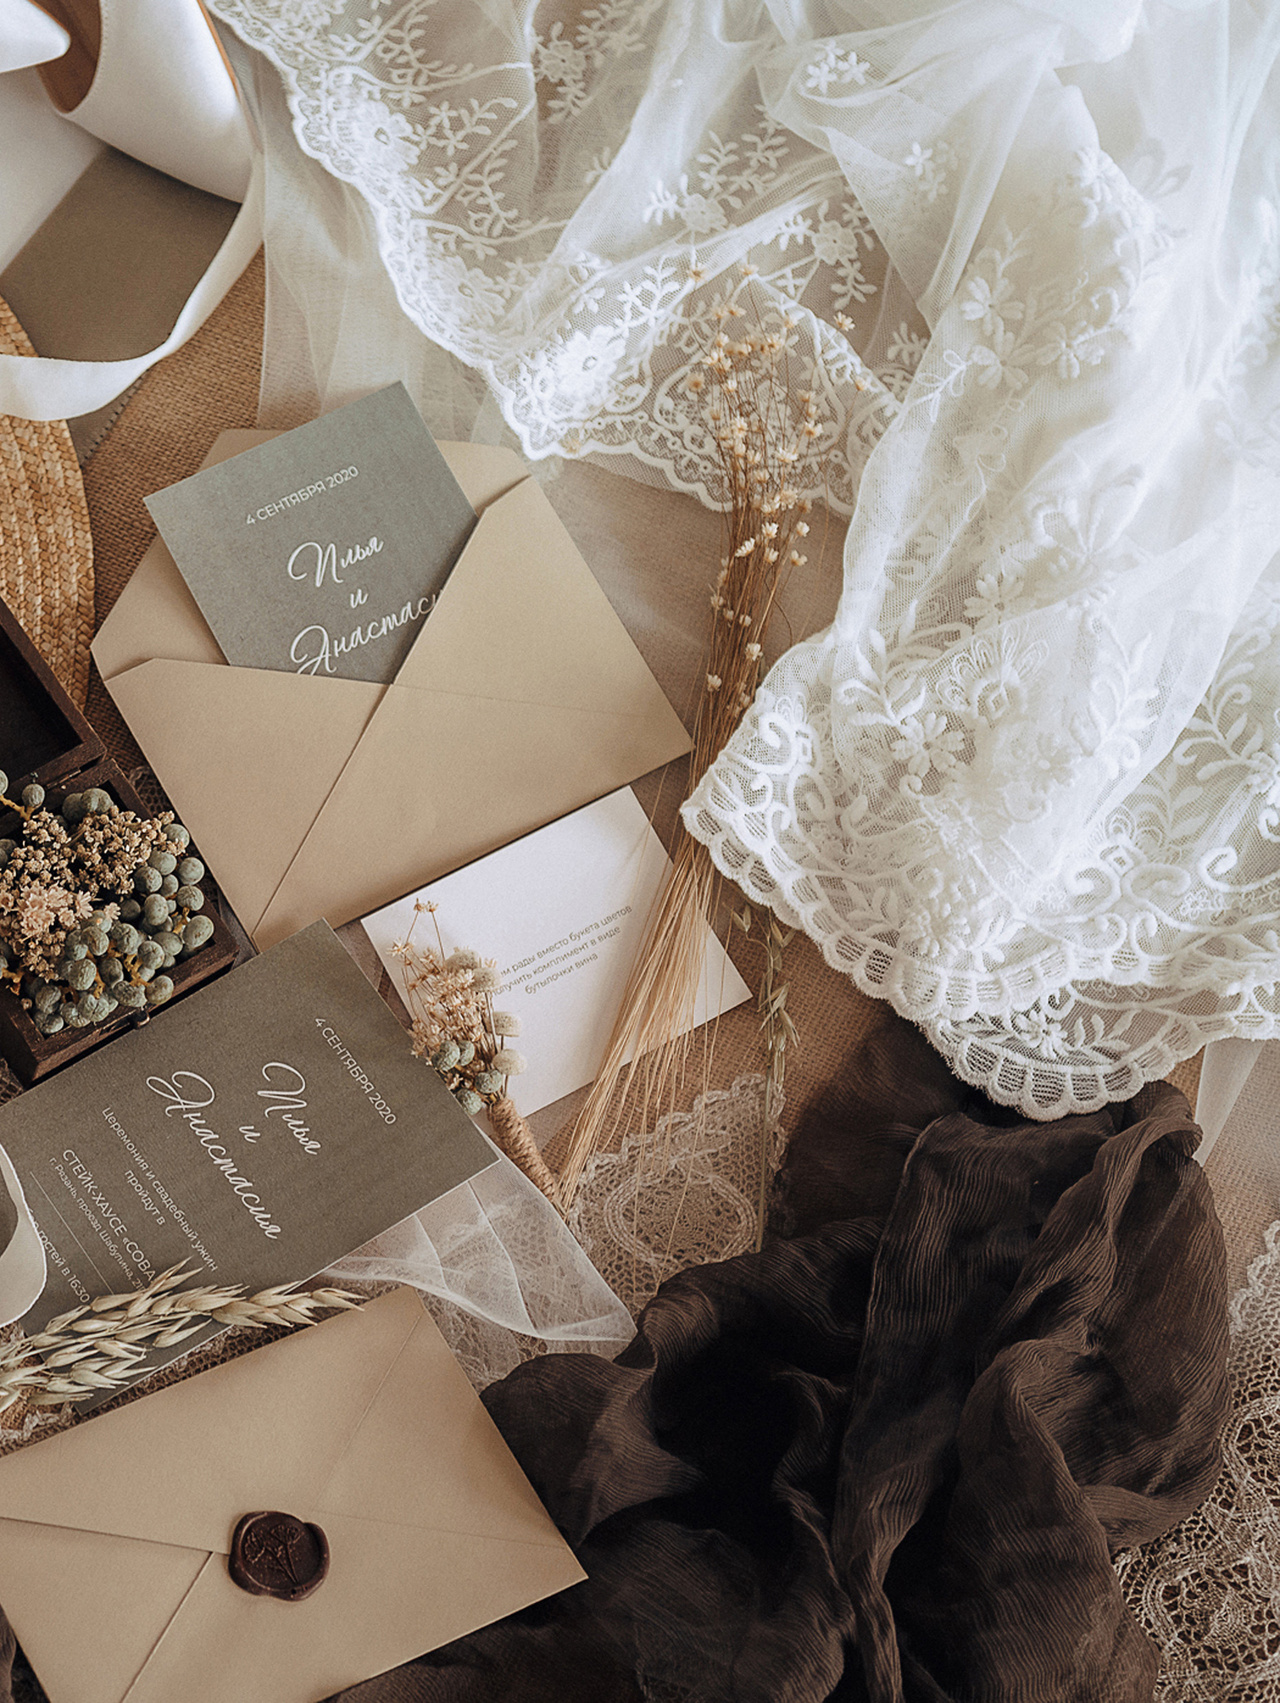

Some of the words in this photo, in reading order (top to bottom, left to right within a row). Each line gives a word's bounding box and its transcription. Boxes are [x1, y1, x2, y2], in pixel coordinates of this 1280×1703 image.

[245, 513, 256, 525] 4
[257, 481, 326, 520] СЕНТЯБРЯ
[326, 466, 358, 488] 2020
[350, 589, 368, 608] и
[511, 955, 536, 972] рады
[536, 938, 569, 959] вместо
[569, 922, 600, 941] букета
[601, 905, 633, 926] цветов
[533, 942, 589, 975] комплимент
[589, 938, 598, 946] в
[597, 926, 621, 942] виде
[525, 965, 574, 994] бутылочки
[575, 953, 598, 968] вина
[315, 1018, 326, 1027] 4
[322, 1027, 374, 1094] СЕНТЯБРЯ
[369, 1092, 396, 1124] 2020
[146, 1071, 281, 1239] Анастасия
[239, 1126, 261, 1143] и
[63, 1149, 127, 1236] СТЕЙК-ХАУСЕ
[102, 1107, 149, 1171] Церемония
[146, 1171, 155, 1180] и
[152, 1180, 198, 1241] свадебный
[191, 1240, 218, 1271] ужин
[125, 1170, 160, 1215] пройдут
[156, 1216, 165, 1225] в
[37, 1229, 66, 1267] гостей
[61, 1267, 70, 1276] в
